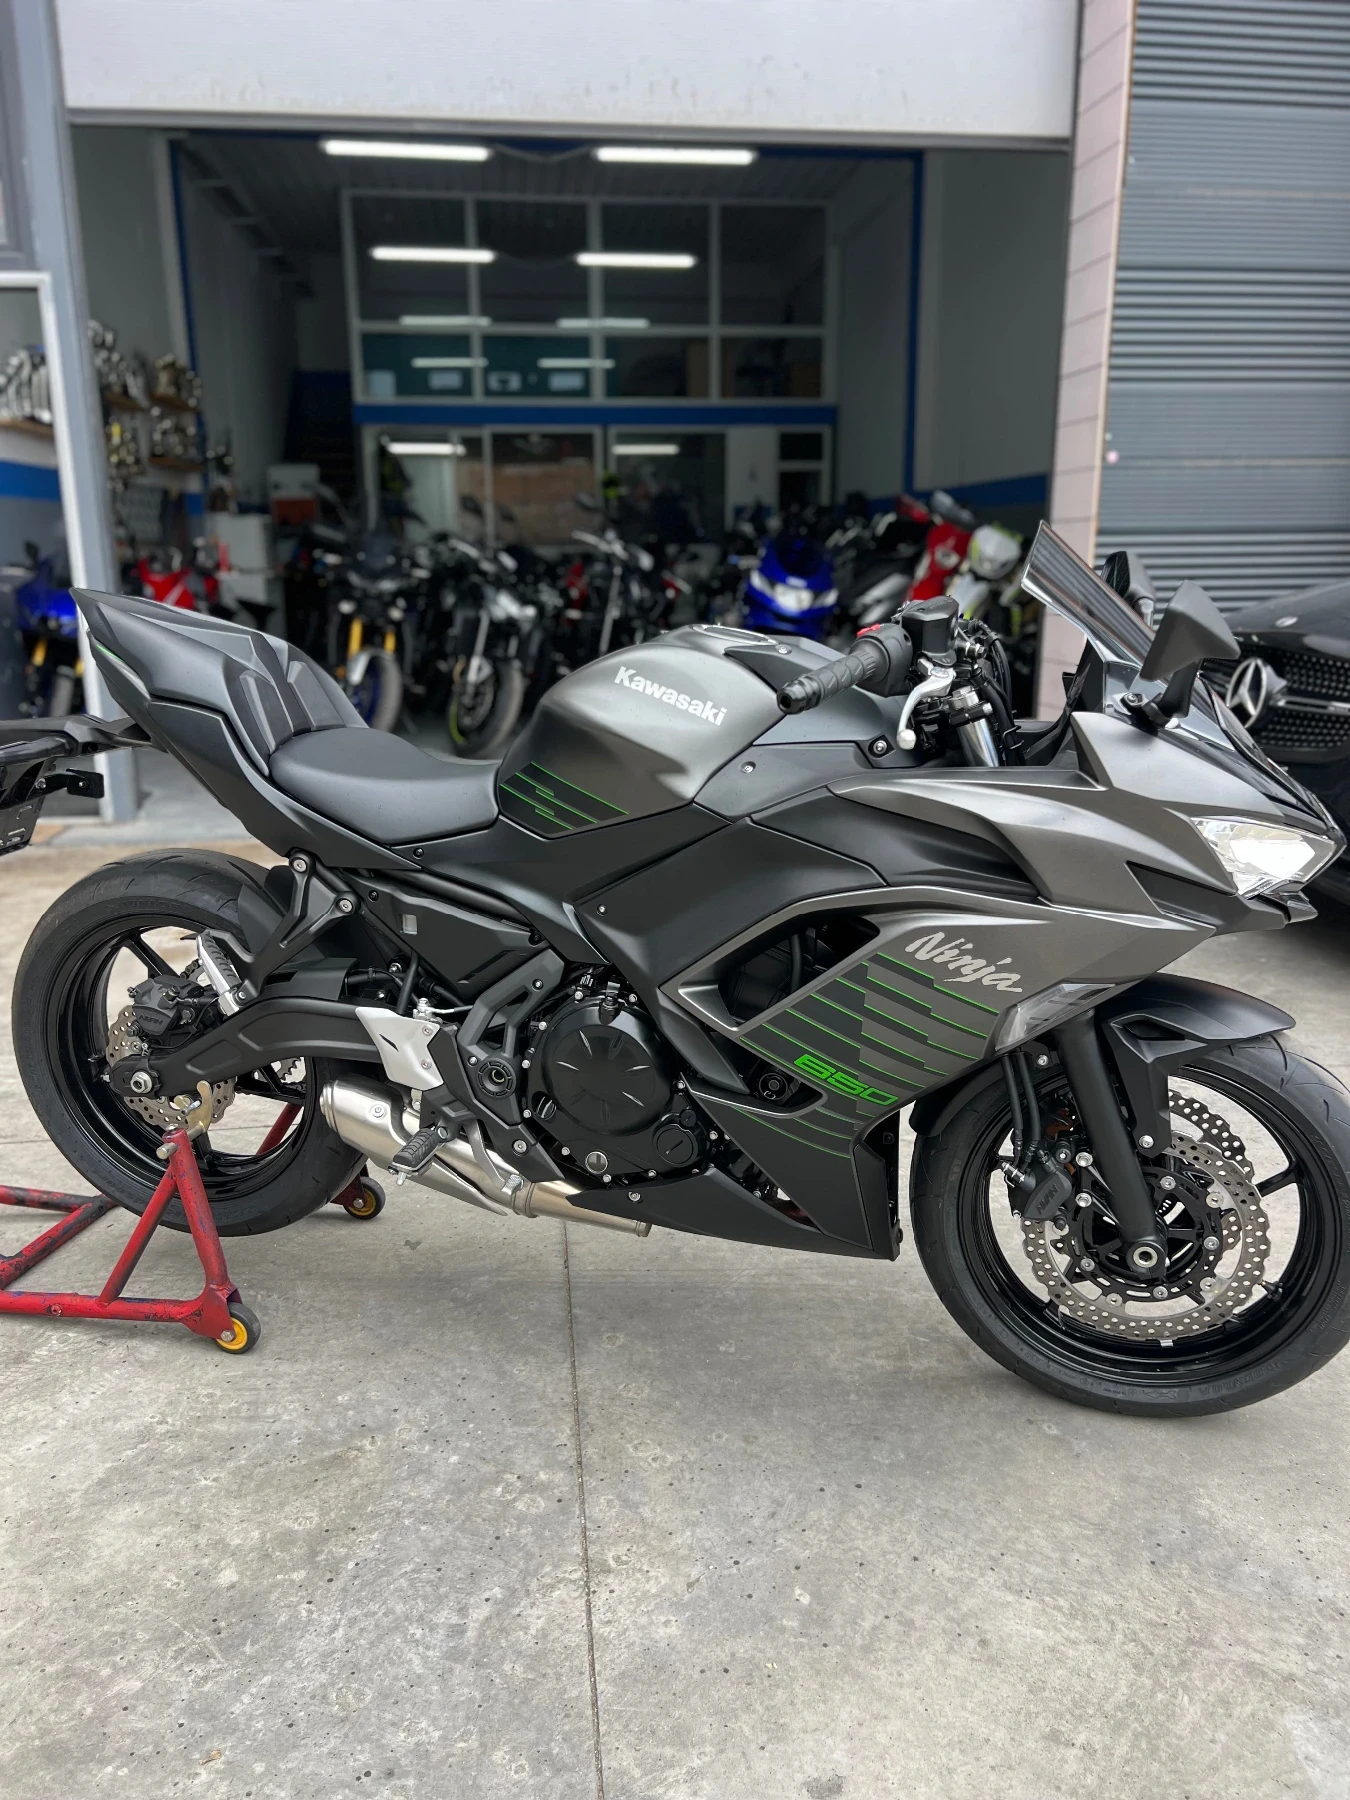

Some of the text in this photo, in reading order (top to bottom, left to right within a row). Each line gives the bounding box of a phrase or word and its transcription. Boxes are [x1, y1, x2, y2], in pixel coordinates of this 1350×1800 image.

[614, 666, 728, 726] Kawasaki
[904, 931, 1023, 993] Ninja
[793, 1053, 899, 1106] 650
